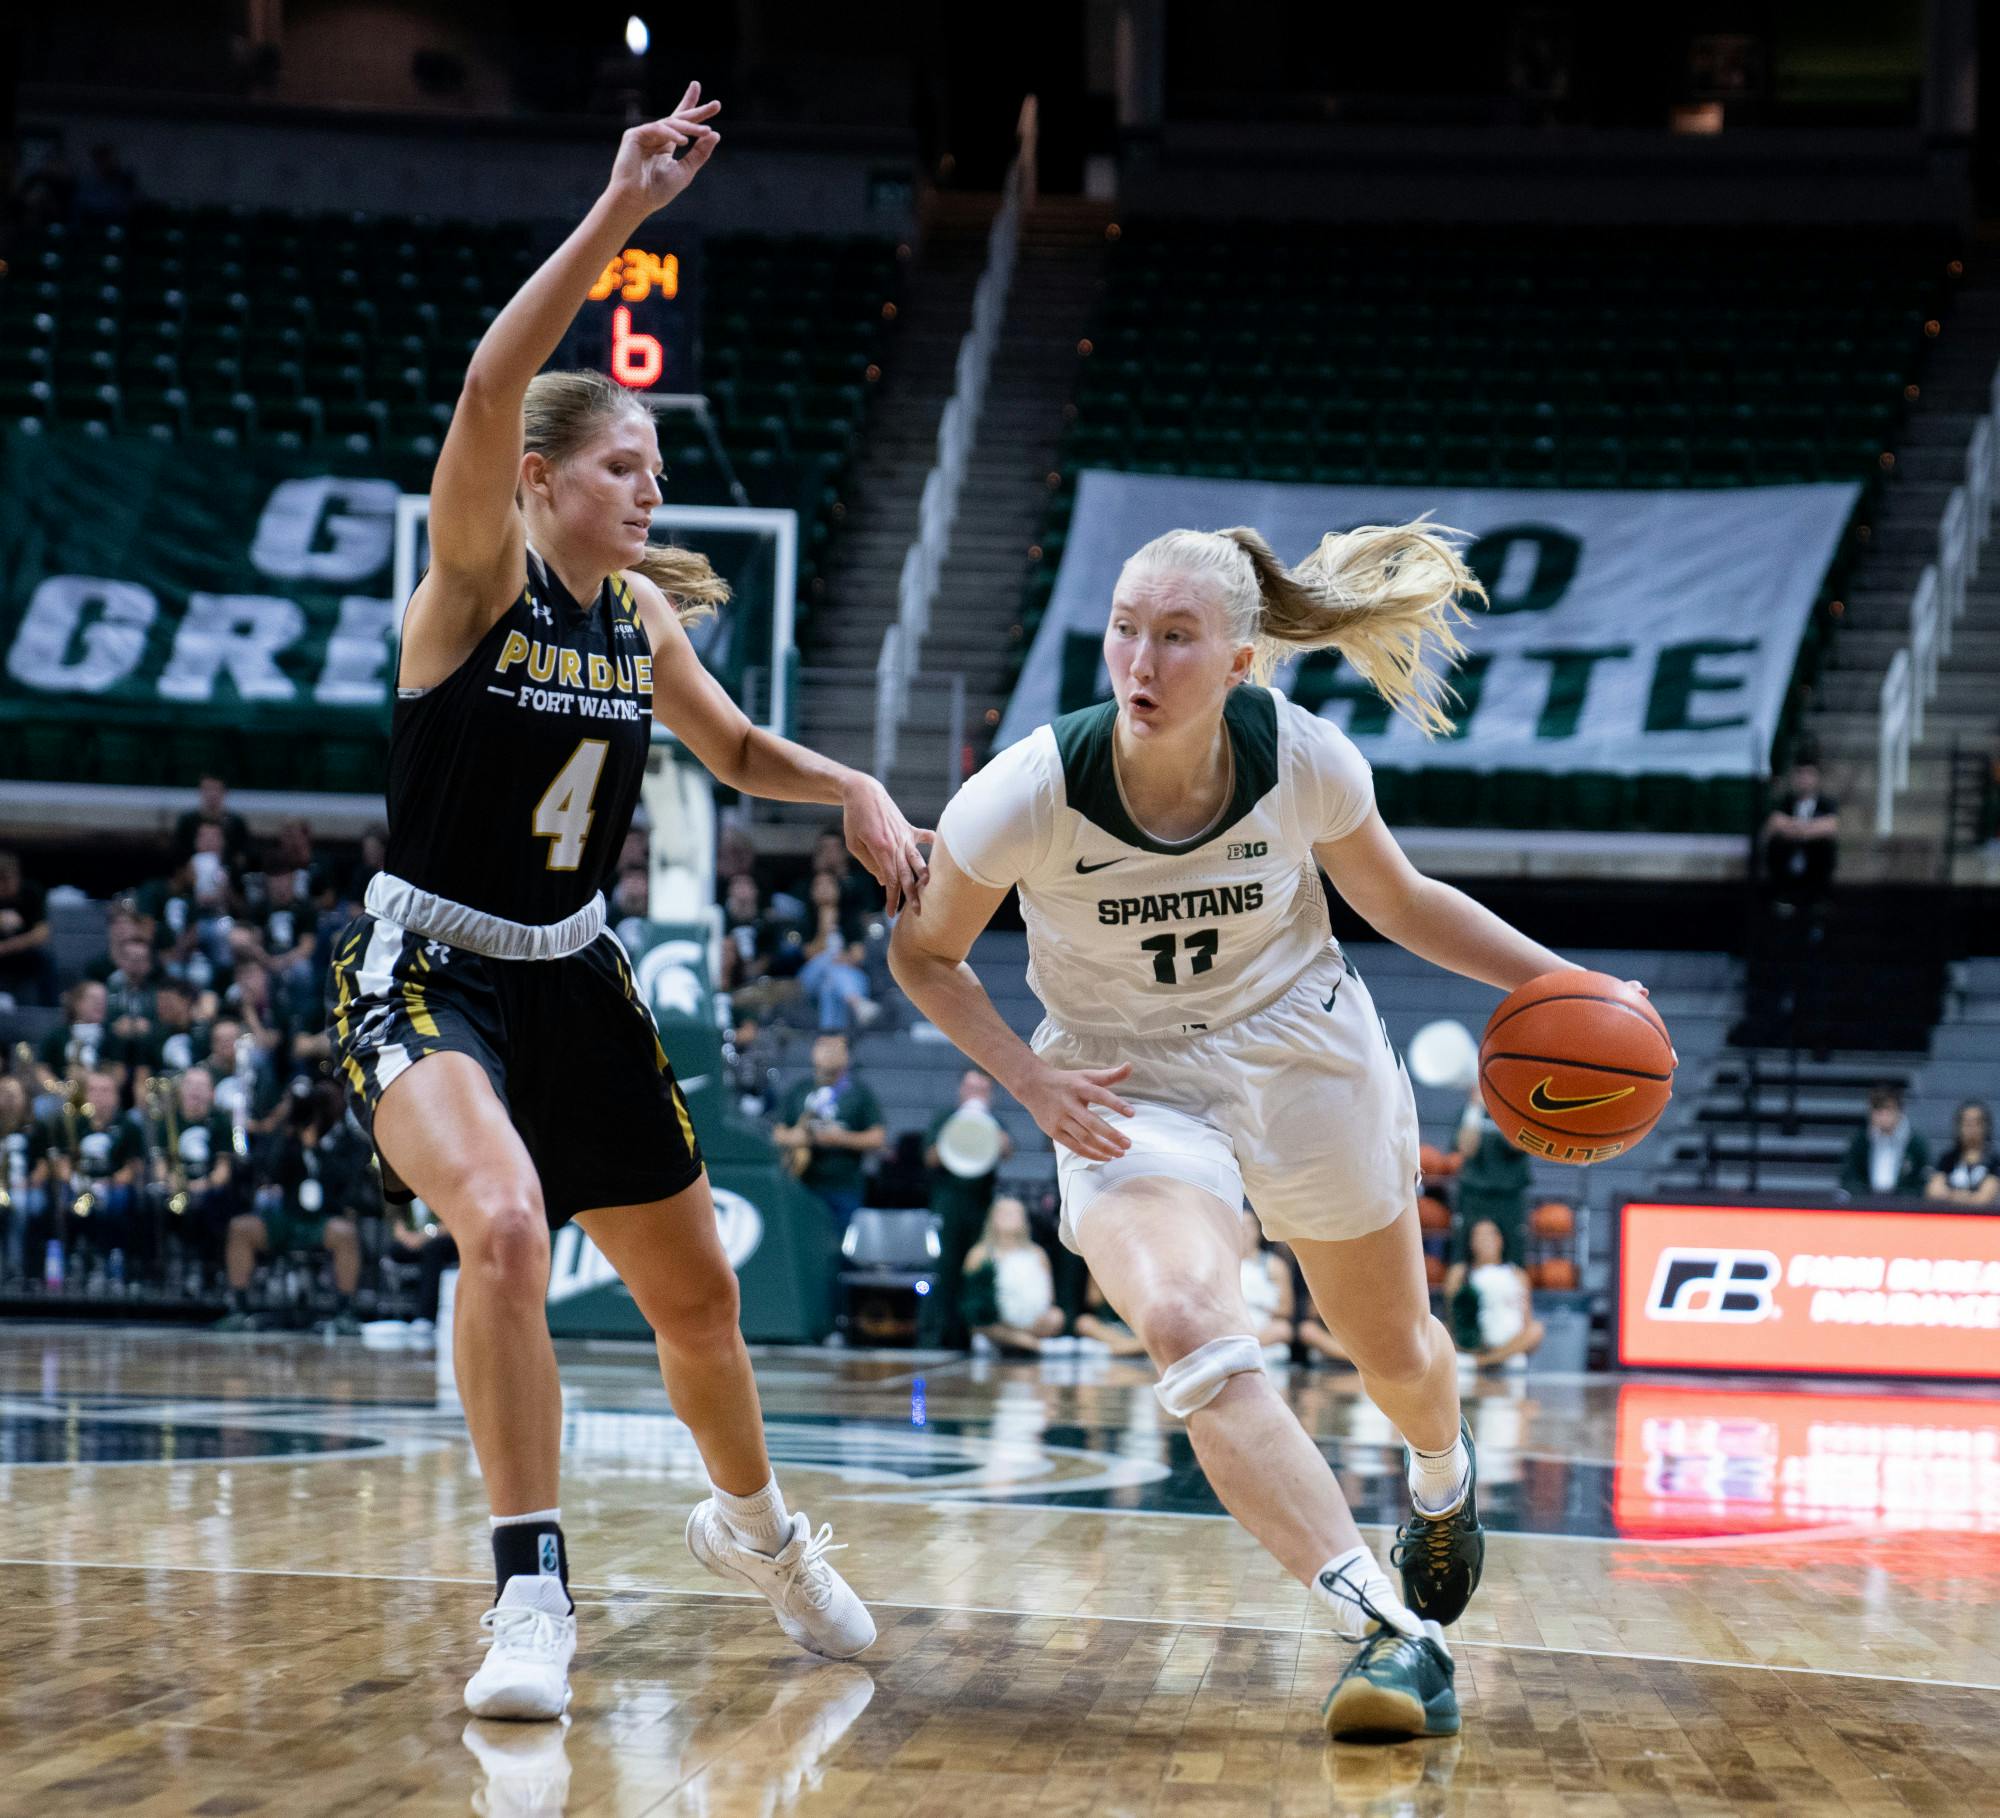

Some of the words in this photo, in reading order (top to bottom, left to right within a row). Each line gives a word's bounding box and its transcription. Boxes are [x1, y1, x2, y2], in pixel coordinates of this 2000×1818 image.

[612, 305, 663, 388] 6
[250, 476, 400, 582] G
[7, 574, 397, 704] GRE
[495, 629, 653, 695] PURDUE
[517, 685, 575, 715] FORT
[577, 693, 640, 721] WAYNE
[532, 737, 610, 871] 4
[1097, 882, 1264, 926] SPARTANS
[1516, 1127, 1625, 1162] ELITE
